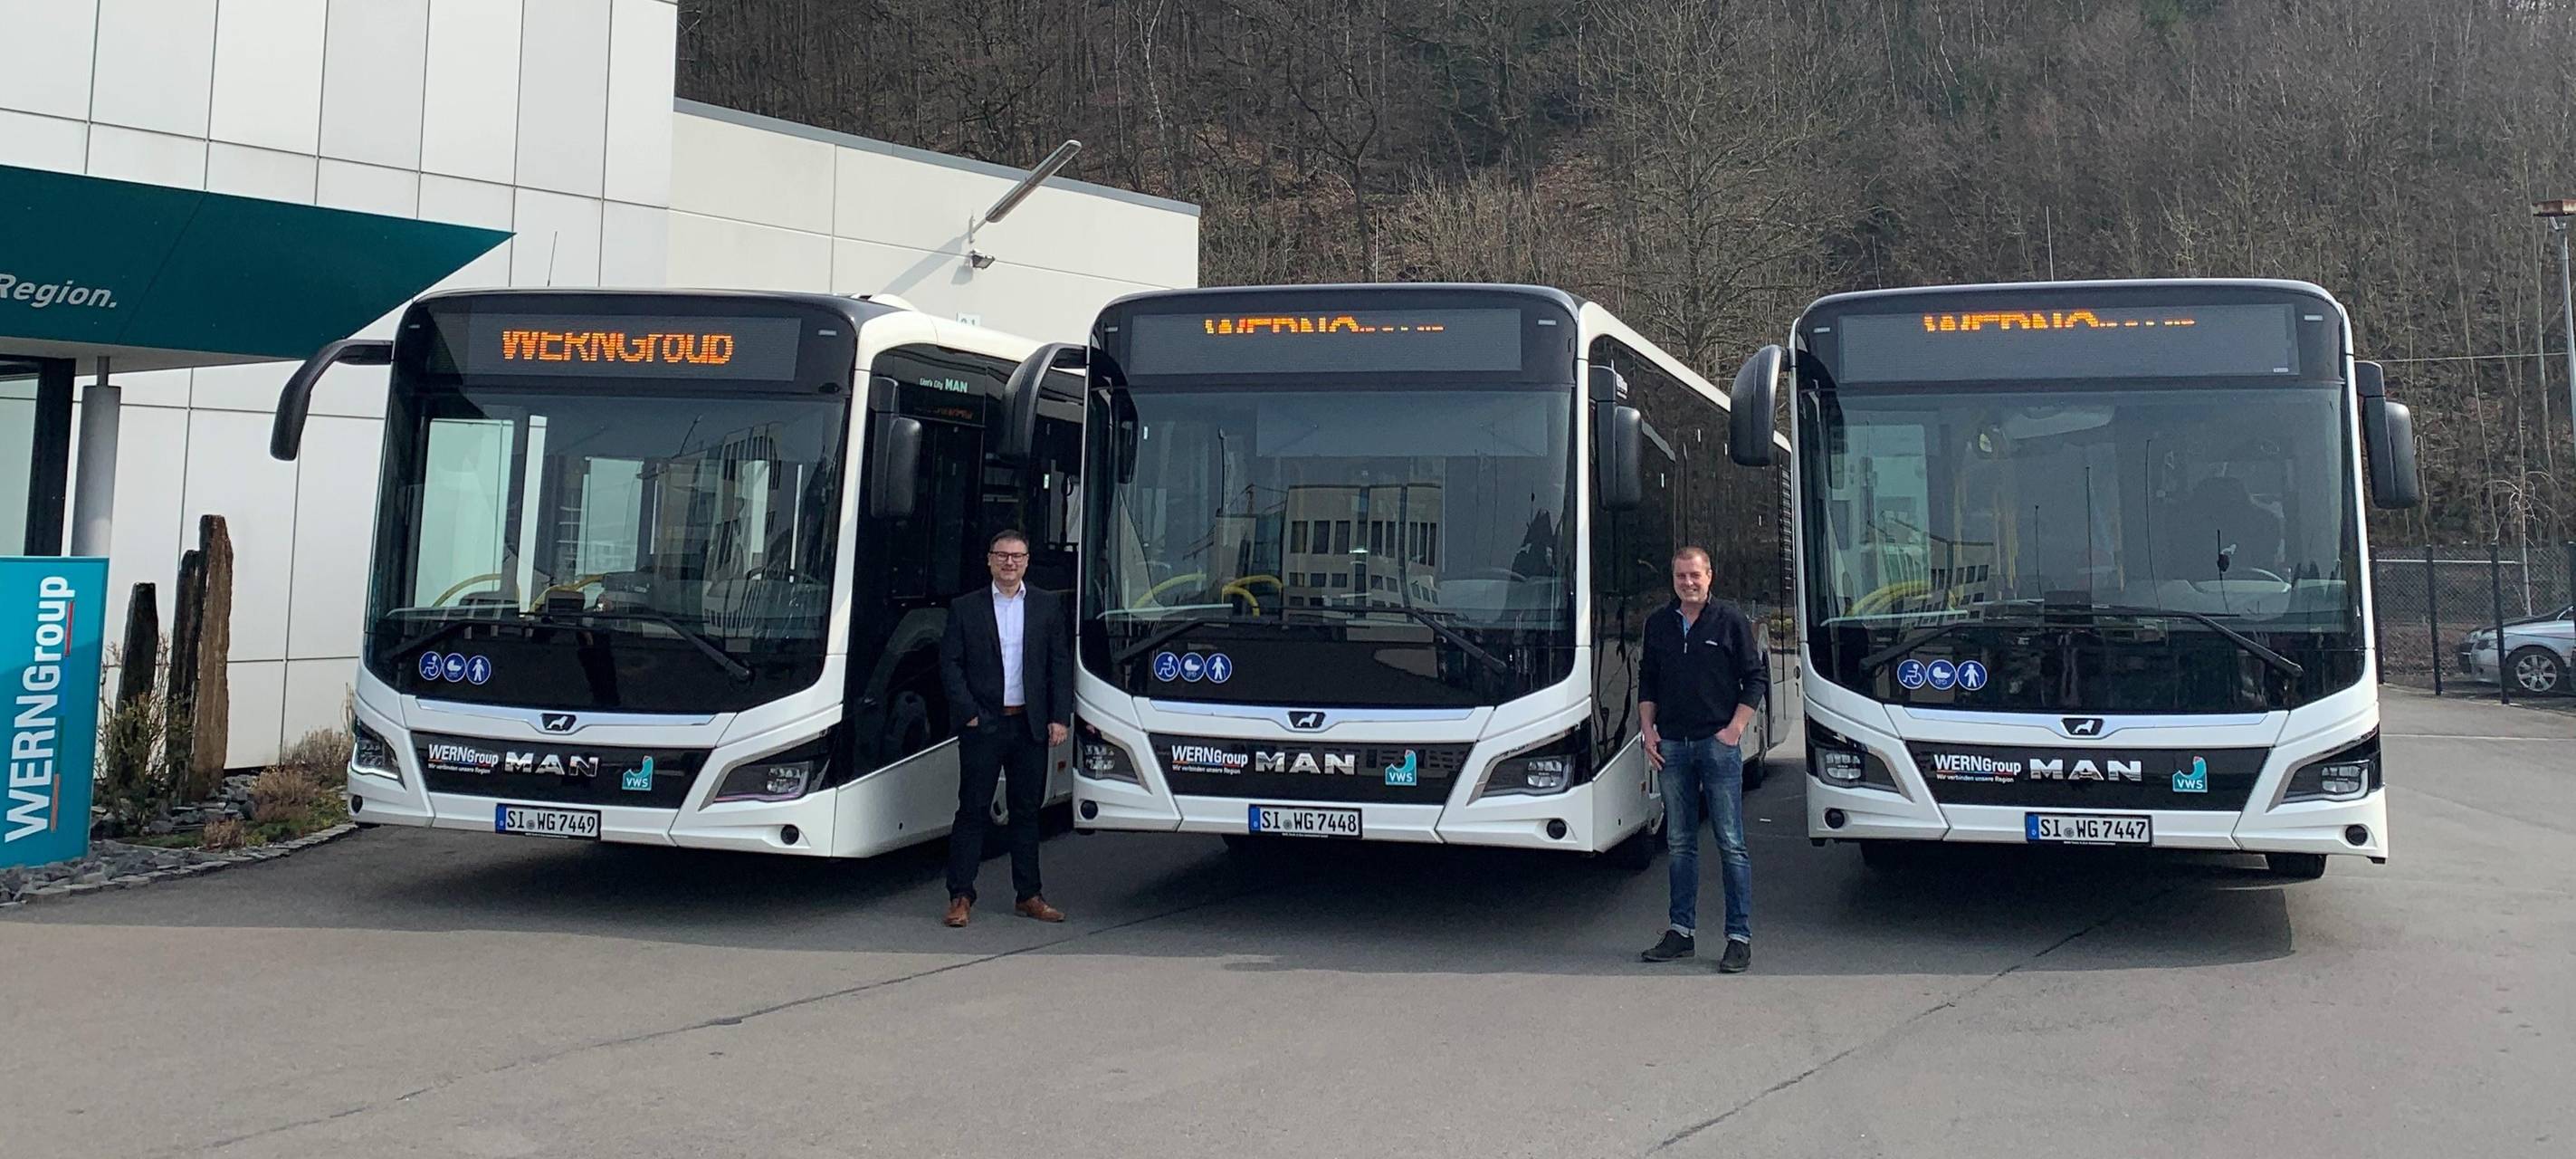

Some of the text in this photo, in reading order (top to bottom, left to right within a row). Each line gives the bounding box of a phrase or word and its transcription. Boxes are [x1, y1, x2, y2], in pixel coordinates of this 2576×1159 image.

[0, 273, 117, 308] Region.
[945, 378, 968, 393] MAN
[5, 576, 75, 843] WERNGroup
[428, 743, 498, 767] WERNGroup
[504, 752, 599, 777] MAN
[1172, 744, 1248, 768] WERNGroup
[1255, 751, 1355, 775] MAN
[1934, 754, 2021, 775] WERNGroup
[1388, 771, 1413, 782] VWS
[2029, 758, 2142, 781] MAN
[626, 777, 649, 788] VWS
[2177, 779, 2203, 790] VWS
[507, 810, 596, 834] SI WG 7449
[1262, 811, 1357, 832] SI WG 7448
[2040, 819, 2146, 839] SI WG 7447
